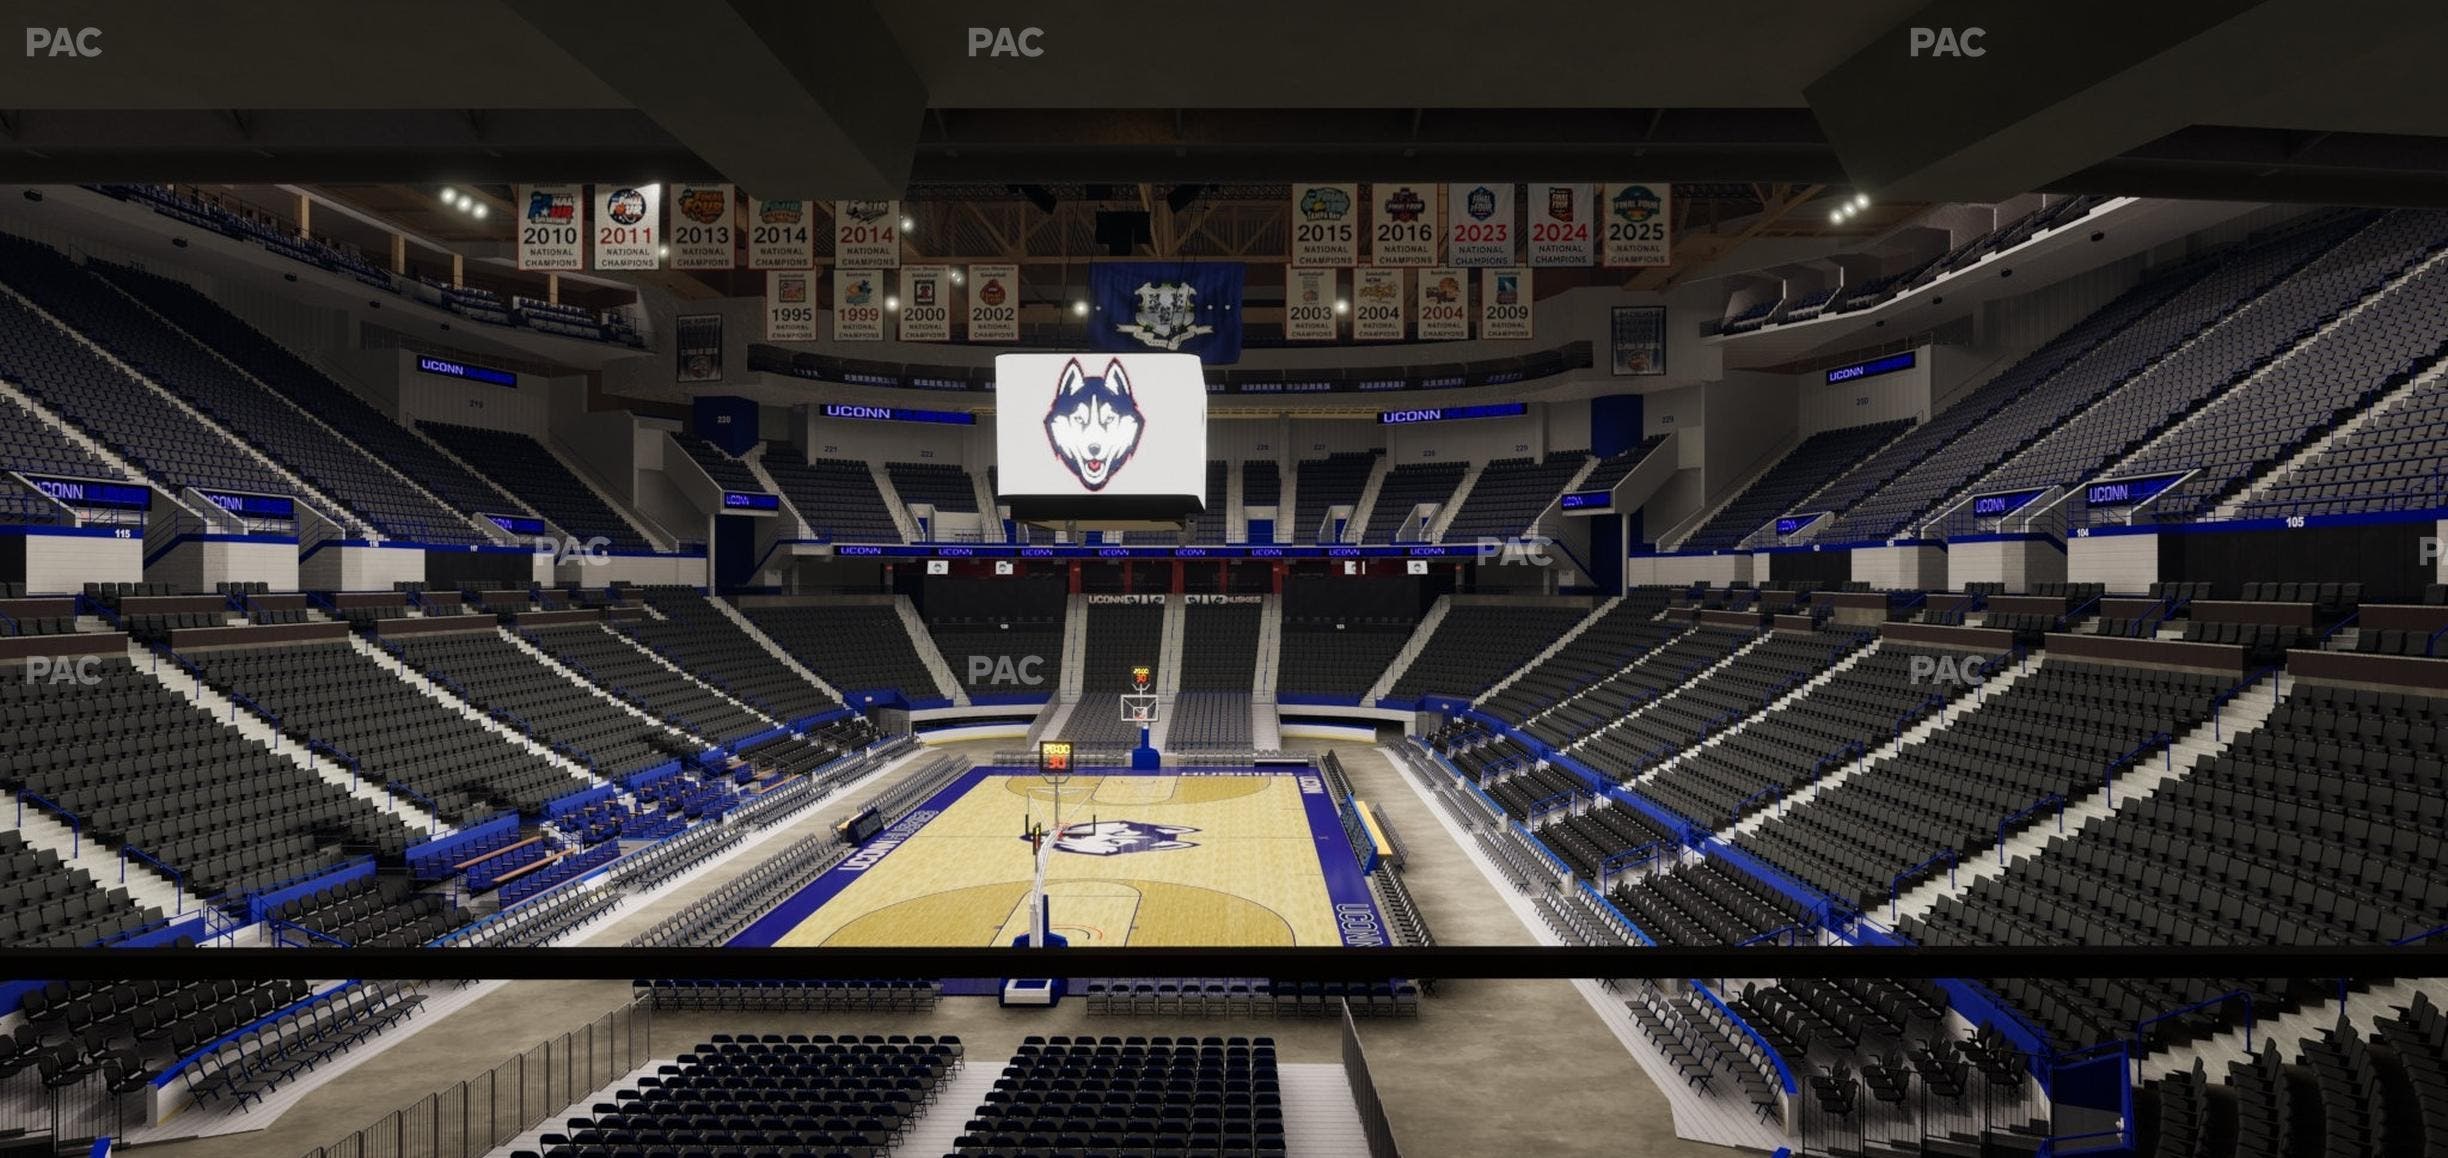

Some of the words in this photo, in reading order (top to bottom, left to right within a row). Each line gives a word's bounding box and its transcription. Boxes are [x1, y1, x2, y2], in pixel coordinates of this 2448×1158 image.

[524, 227, 577, 245] 2010
[600, 227, 652, 245] 2011
[676, 226, 729, 244] 2013
[754, 226, 807, 244] 2014
[840, 226, 895, 244] 2014
[1298, 224, 1352, 242] 2015
[1378, 224, 1432, 242] 2016
[1455, 224, 1507, 242] 2023
[1532, 224, 1588, 242] 2024
[1609, 223, 1664, 241] 2025
[682, 248, 726, 256] NATIONAL
[1459, 246, 1504, 254] NATIONAL
[1538, 245, 1583, 253] NATIONAL
[1456, 257, 1508, 265] CHAMPIONS
[1535, 256, 1587, 264] CHAMPIONS
[772, 308, 812, 321] 1995
[839, 308, 879, 321] 1999
[904, 307, 945, 321] 2000
[973, 307, 1014, 321] 2002
[1290, 306, 1332, 320] 2003
[1358, 306, 1400, 320] 2004
[1422, 306, 1464, 320] 2004
[1486, 306, 1529, 320] 2009
[422, 359, 463, 375] UCONN
[1829, 366, 1864, 381] UCONN
[827, 405, 891, 419] UCONN
[1383, 410, 1441, 423] UCONN
[2089, 484, 2129, 503] UCONN
[1975, 498, 2006, 513] UCONN
[2285, 516, 2304, 528] 105
[115, 529, 131, 538] 115
[2076, 528, 2089, 538] 104
[840, 547, 881, 555] UCONN
[938, 548, 973, 556] UCONN
[1021, 548, 1053, 556] UCONN
[1099, 548, 1129, 556] UCONN
[1175, 548, 1206, 556] UCONN
[1251, 548, 1283, 556] UCONN
[1328, 548, 1360, 556] UCONN
[1410, 547, 1445, 556] UCONN
[1088, 595, 1126, 604] UCONN
[1042, 743, 1071, 755] 20:00
[1048, 754, 1067, 769] 30
[837, 840, 902, 872] UCONN
